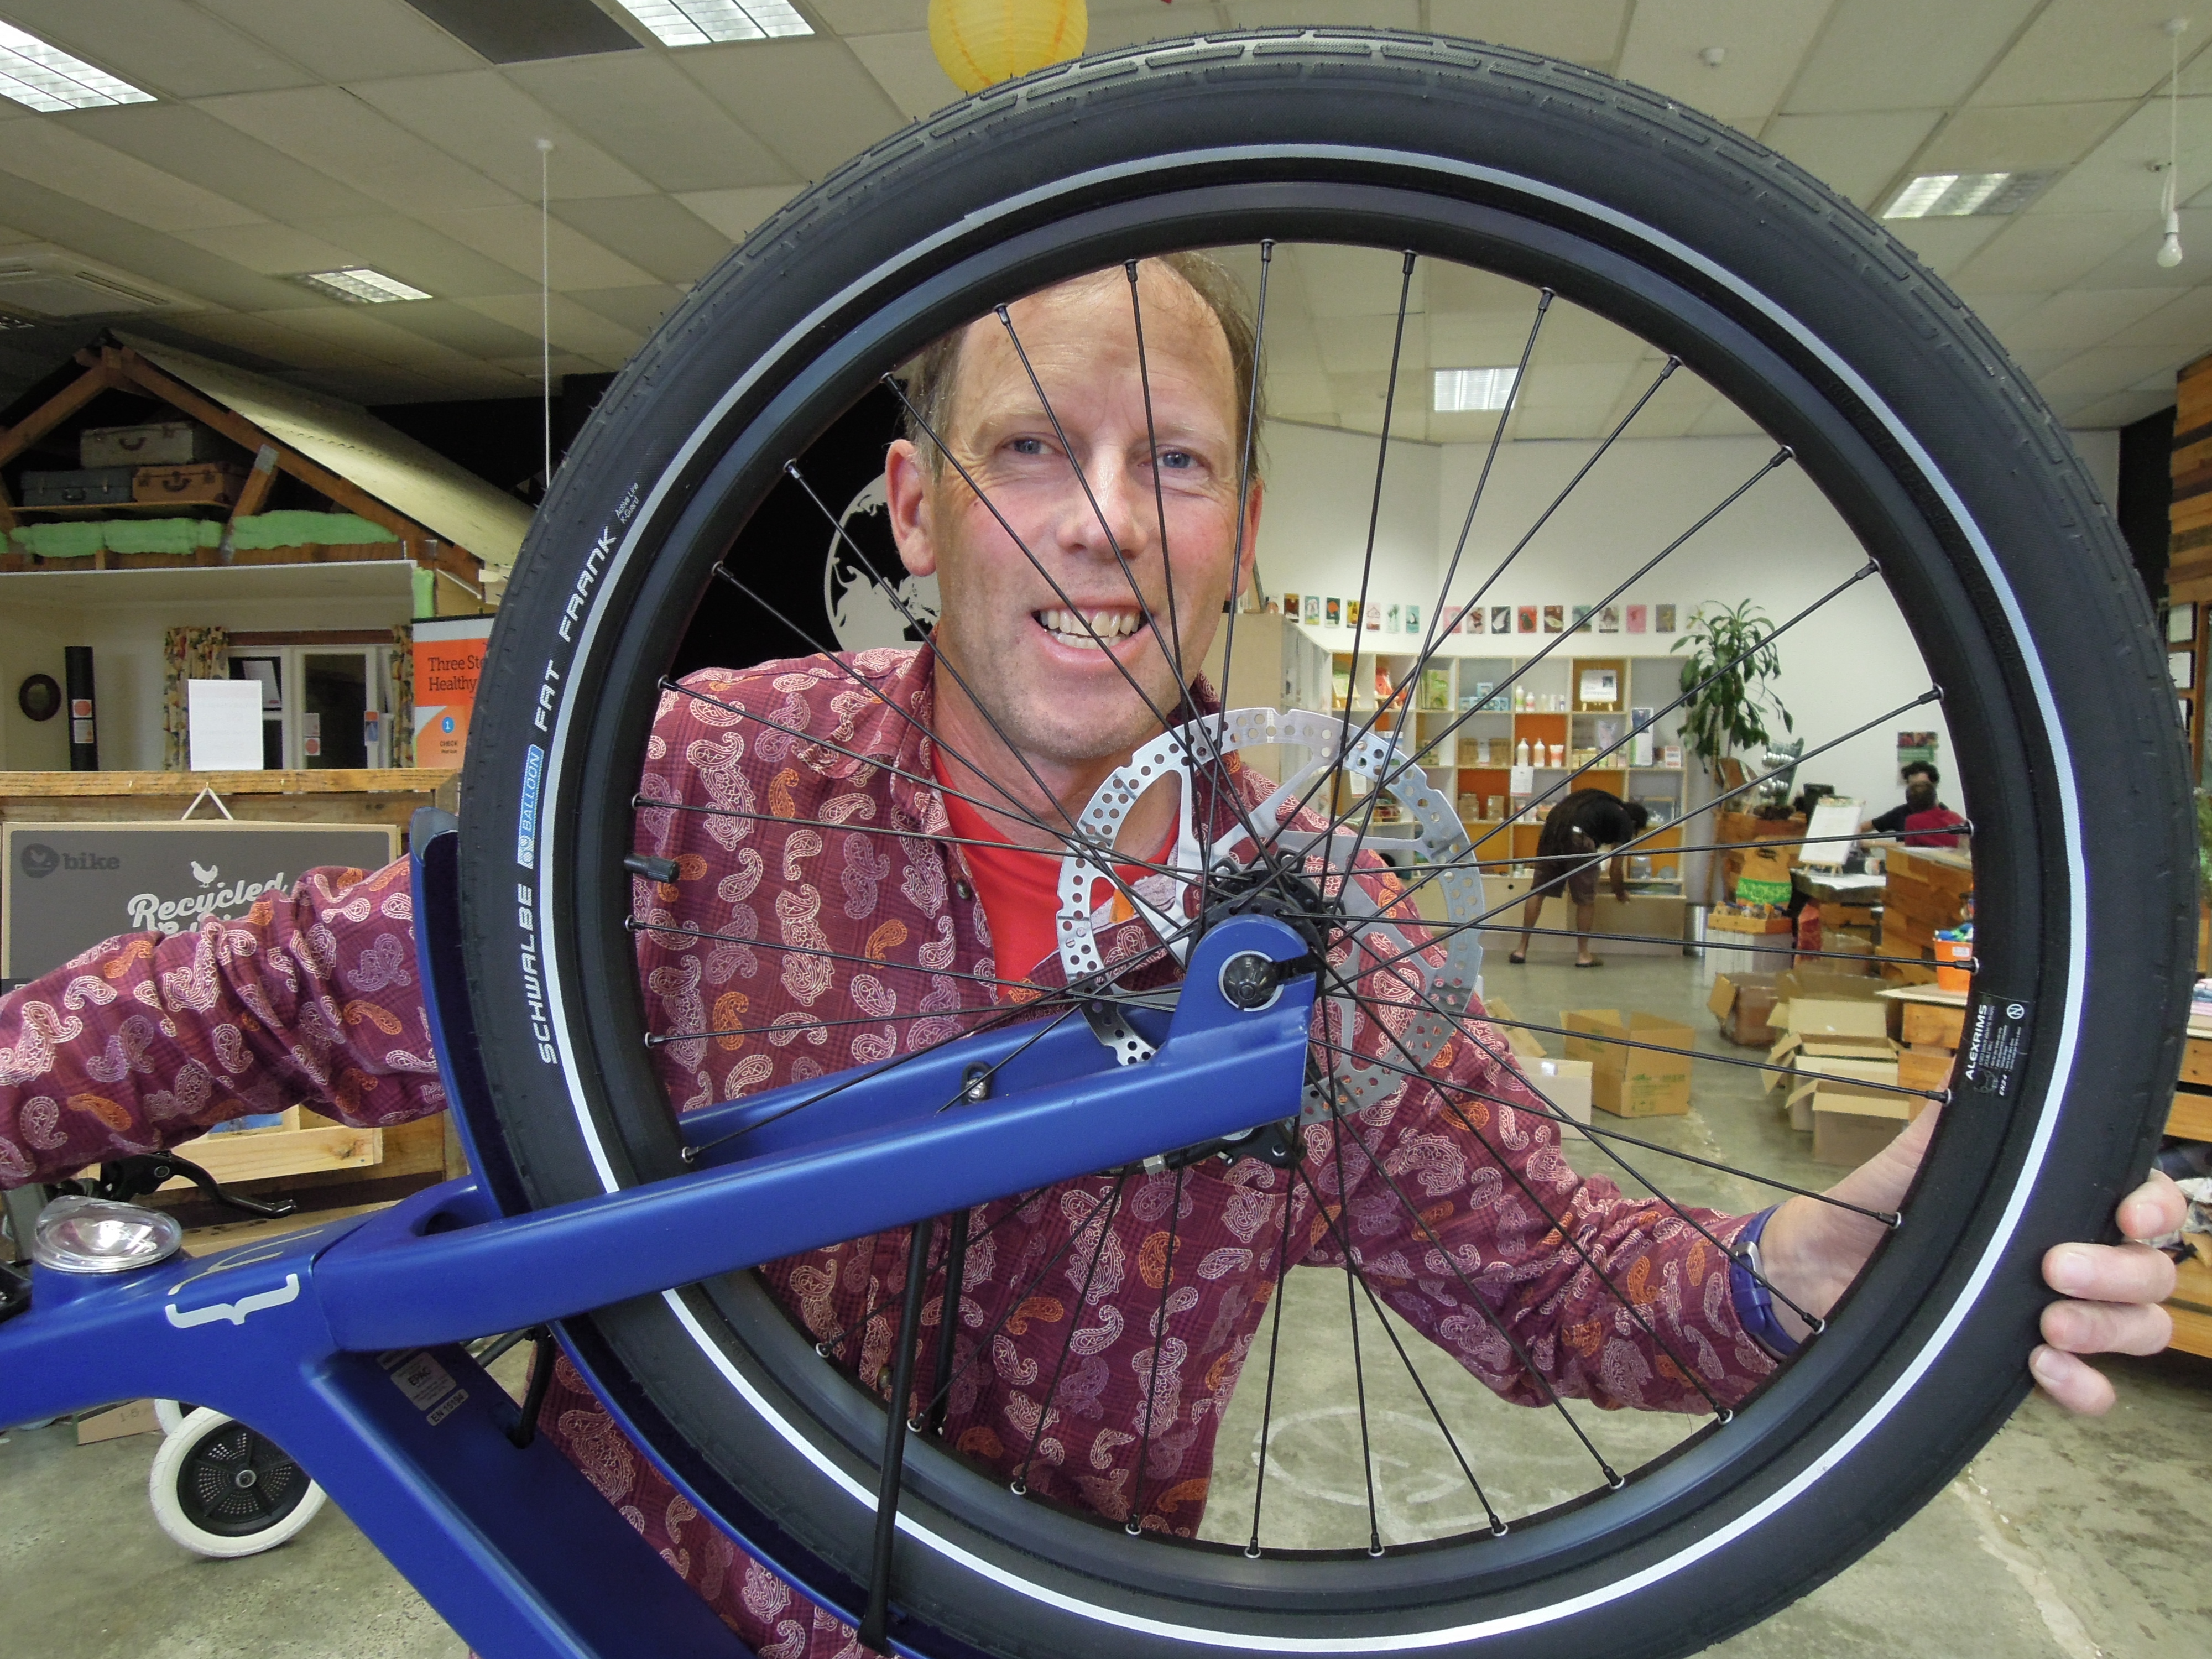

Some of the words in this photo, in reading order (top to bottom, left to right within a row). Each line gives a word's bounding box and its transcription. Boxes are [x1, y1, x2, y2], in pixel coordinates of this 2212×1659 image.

[559, 526, 617, 643] FRANK
[427, 656, 465, 671] Three
[428, 675, 478, 695] Healthy
[534, 660, 559, 732] FAT
[521, 751, 540, 832] BALLOON
[62, 853, 120, 870] bike
[128, 872, 288, 928] Recycled
[518, 883, 557, 1065] SCHWALBE
[1965, 1004, 1987, 1081] ALEXRIMS
[430, 1410, 444, 1423] EN
[443, 1392, 465, 1412] 15194
